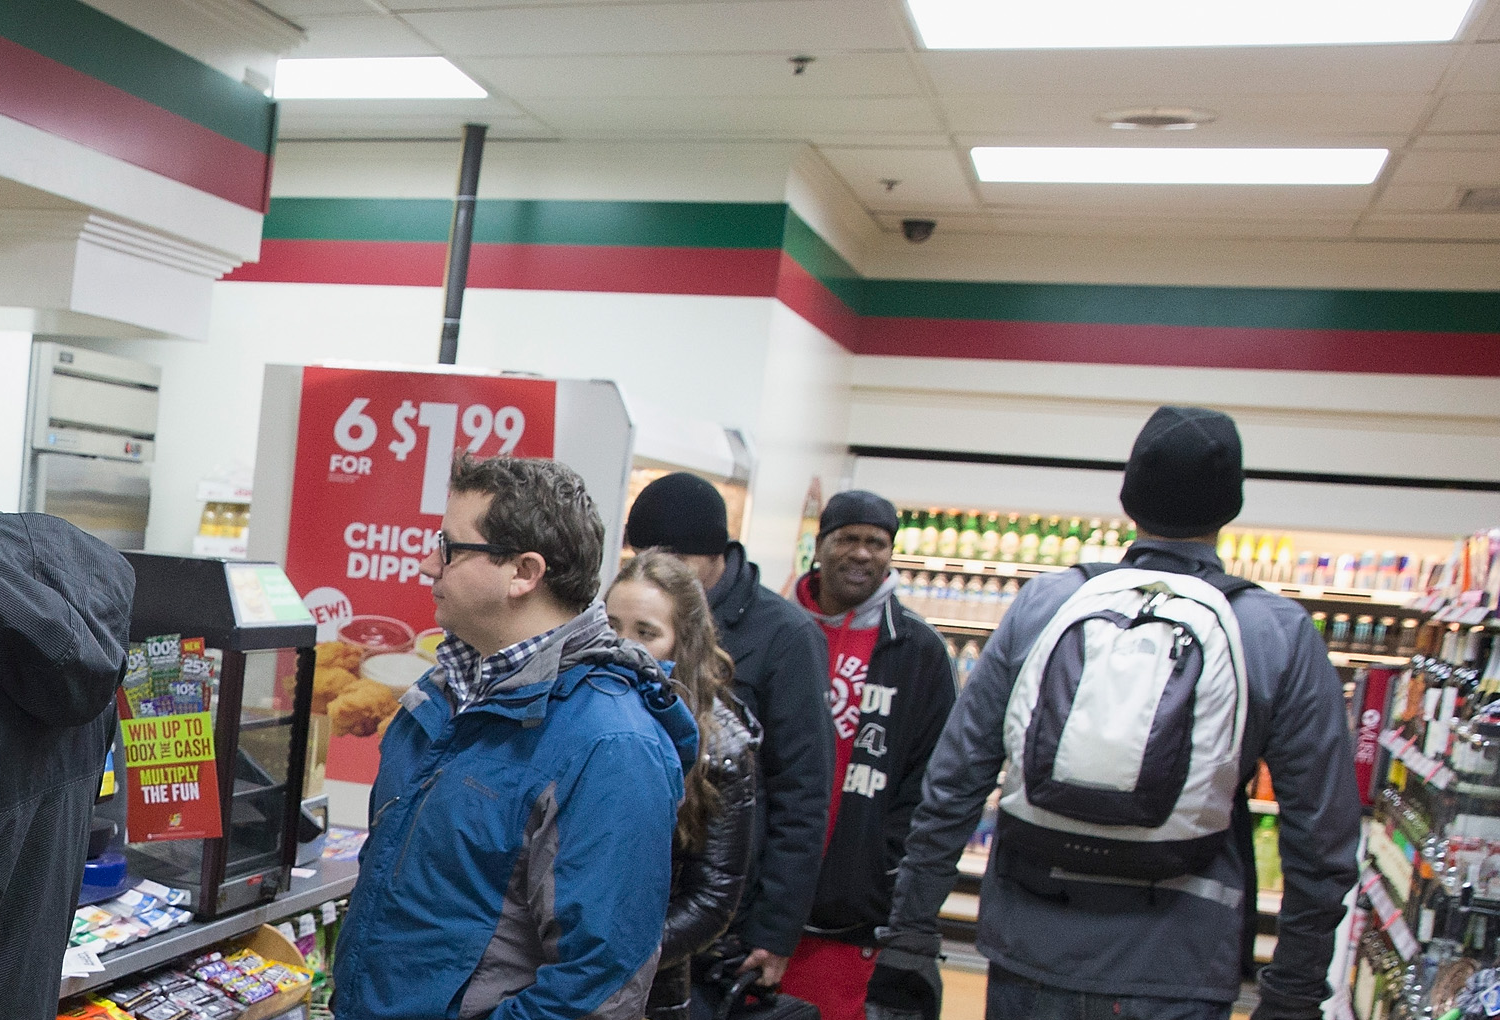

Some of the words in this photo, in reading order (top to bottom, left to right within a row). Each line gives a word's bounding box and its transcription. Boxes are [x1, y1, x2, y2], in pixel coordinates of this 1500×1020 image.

[333, 397, 379, 453] 6
[329, 454, 373, 476] FOR
[343, 521, 440, 557] CHICK
[346, 552, 434, 586] DIPP
[128, 722, 158, 742] WIN
[162, 721, 182, 739] UP
[184, 718, 204, 736] TO
[125, 743, 156, 763] 100X
[174, 738, 212, 758] CASH
[139, 765, 199, 786] MULTIPLY
[141, 785, 168, 804] THE
[172, 782, 200, 801] FUN
